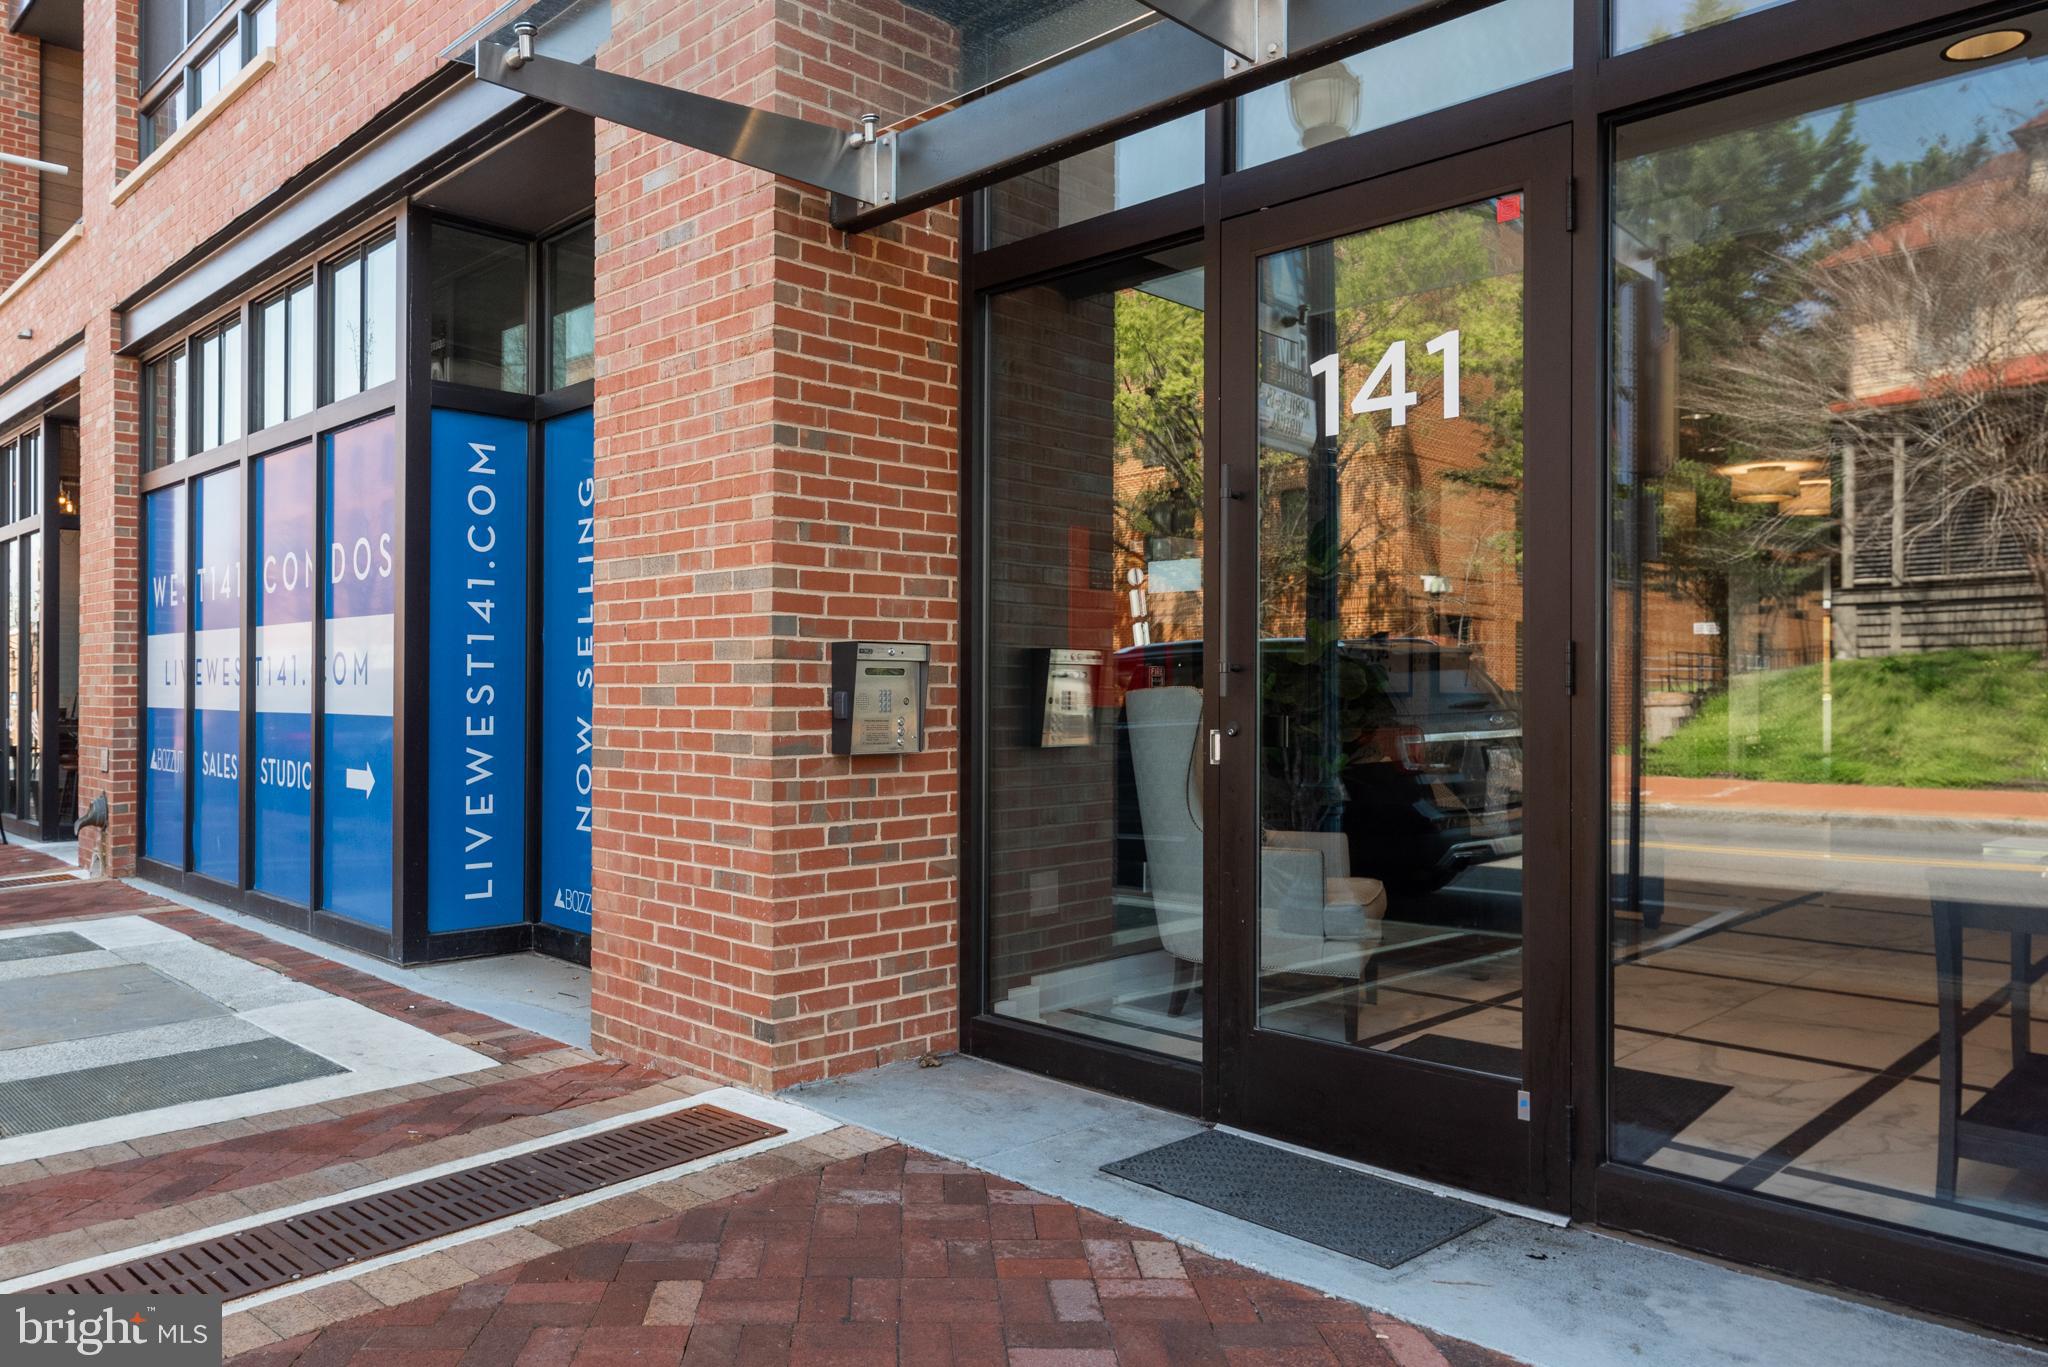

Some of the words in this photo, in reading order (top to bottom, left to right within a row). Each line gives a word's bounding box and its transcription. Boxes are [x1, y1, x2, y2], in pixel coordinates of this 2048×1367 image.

[1310, 330, 1460, 437] 141
[153, 562, 240, 609] WET141
[577, 478, 595, 688] SELLING
[165, 650, 368, 686] LIVEWEST141.OM
[465, 442, 496, 900] LIVEWEST141.COM
[157, 748, 185, 773] BOZZUT
[202, 751, 238, 780] SALES
[260, 757, 311, 790] STUDIO
[576, 716, 593, 832] NOW
